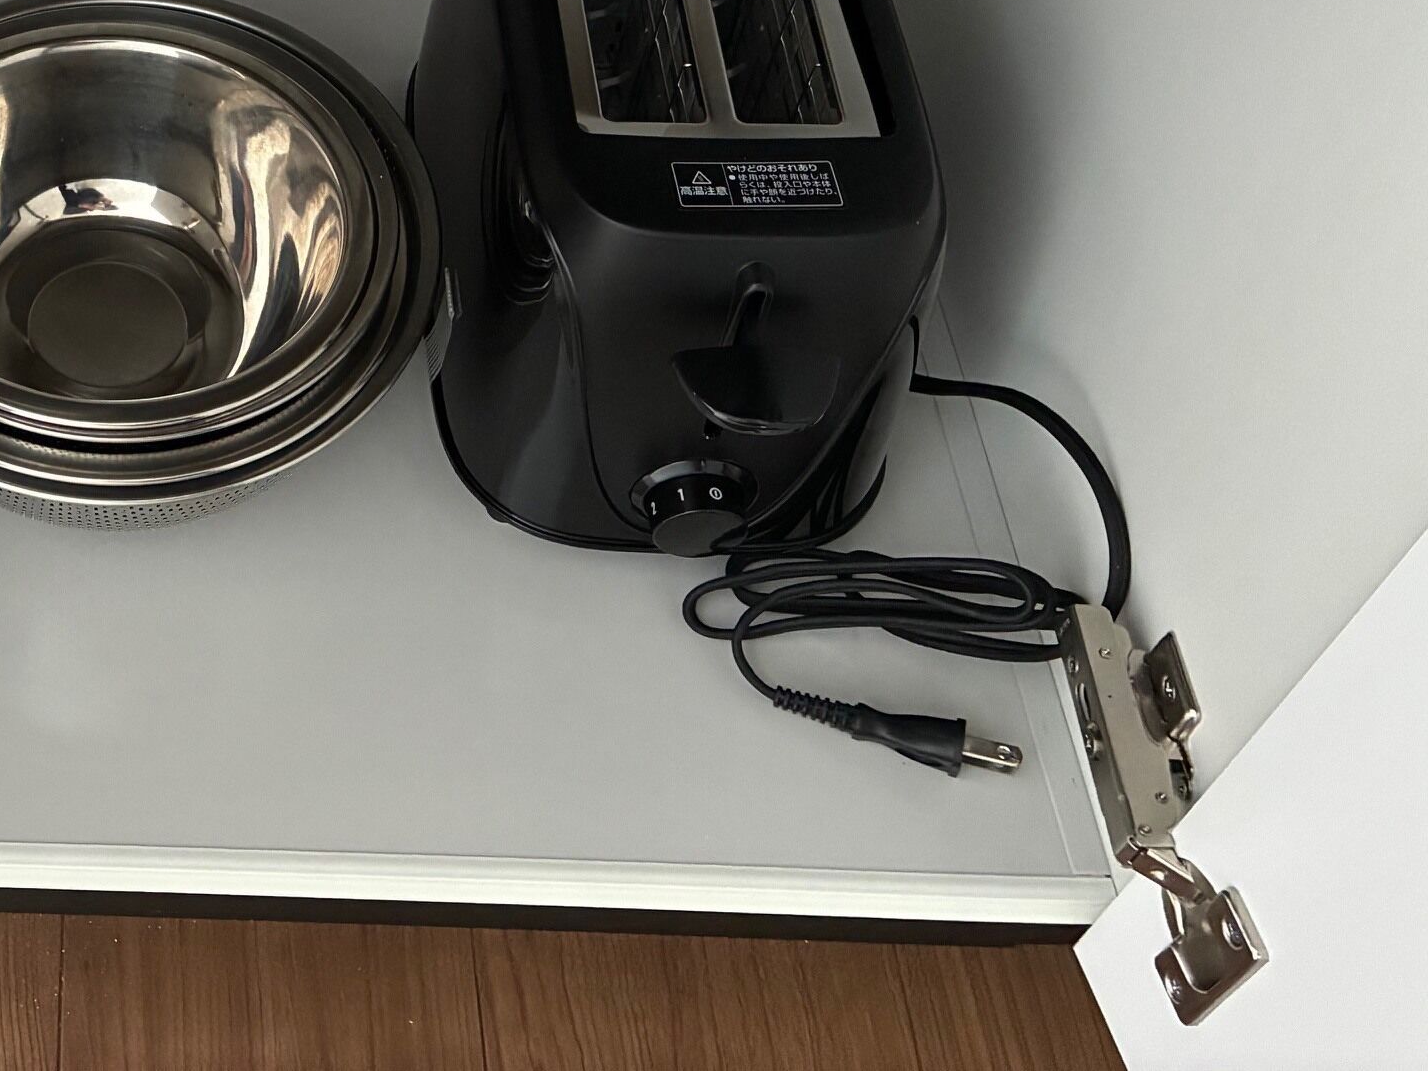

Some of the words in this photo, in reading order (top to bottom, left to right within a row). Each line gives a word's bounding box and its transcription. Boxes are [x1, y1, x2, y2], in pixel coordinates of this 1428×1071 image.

[727, 164, 817, 173] やけどのおそれあり
[680, 186, 729, 196] 高温注意
